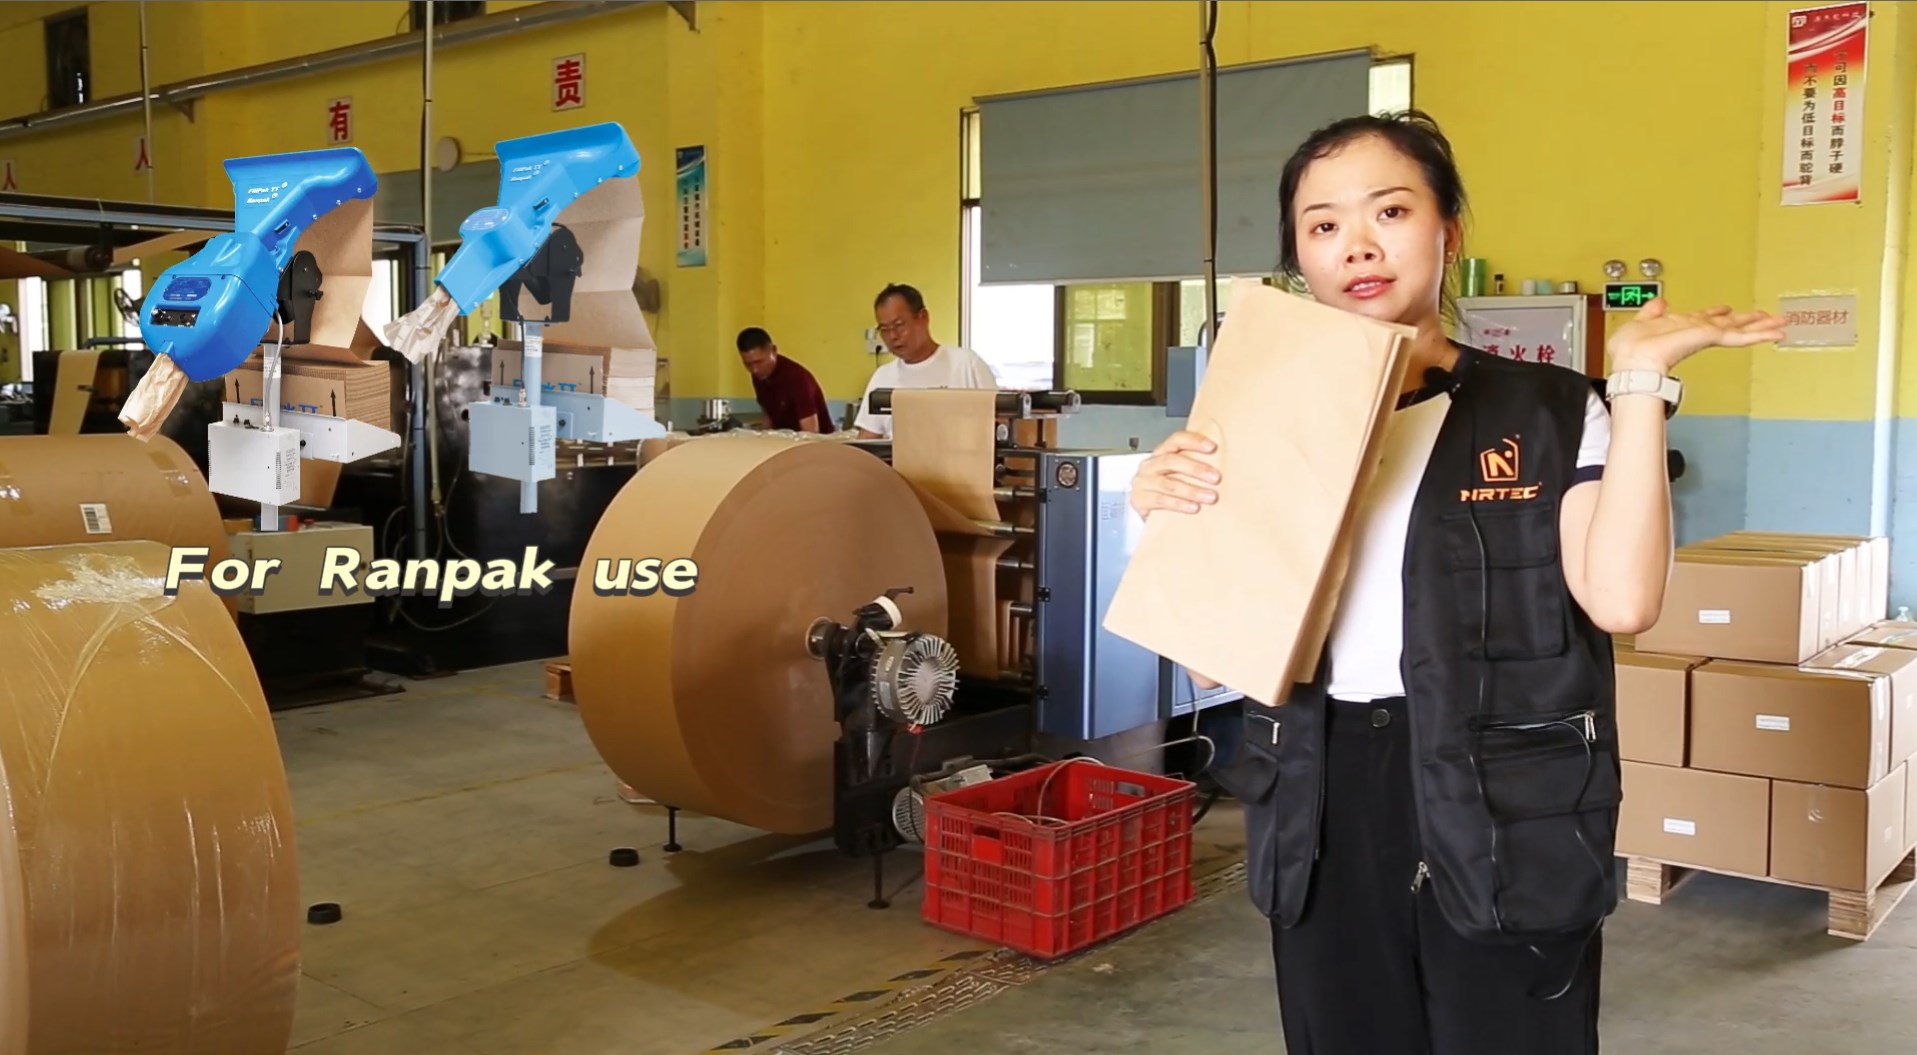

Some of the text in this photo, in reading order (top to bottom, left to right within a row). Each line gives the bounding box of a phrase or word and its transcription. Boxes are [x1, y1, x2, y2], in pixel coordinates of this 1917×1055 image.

[3, 60, 582, 191] 人 人 有 责
[1785, 311, 1848, 325] 消防器材
